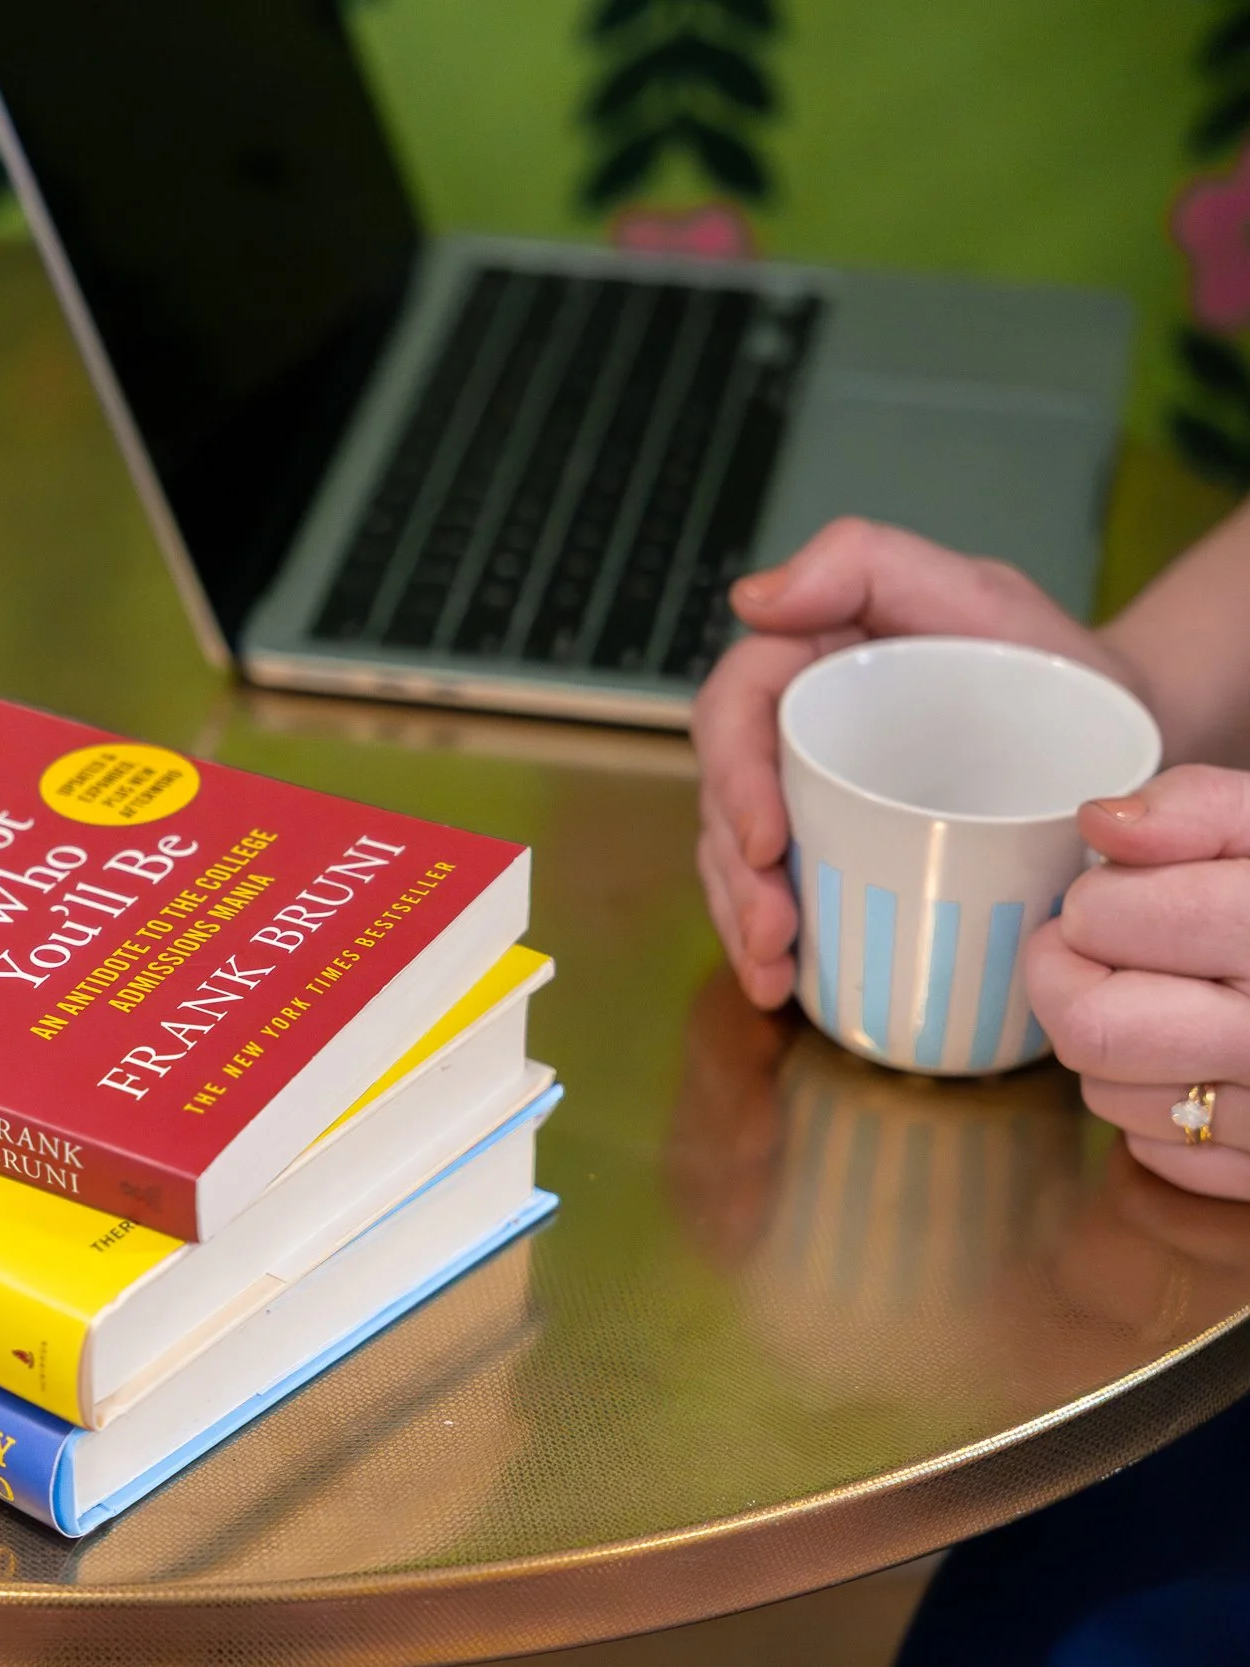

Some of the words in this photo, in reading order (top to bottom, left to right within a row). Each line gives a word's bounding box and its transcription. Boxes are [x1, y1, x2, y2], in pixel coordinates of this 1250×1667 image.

[30, 1014, 69, 1041] AN
[56, 939, 151, 1016] ANTIDOTE
[135, 919, 174, 940] TO
[159, 889, 209, 919] THE
[195, 828, 279, 890] COLLEGE
[102, 834, 199, 885] Be
[108, 920, 222, 1014] ADMISSIONS
[207, 874, 276, 920] MANIA
[96, 955, 277, 1101] FRANK
[250, 834, 406, 954] BRUNI
[183, 1082, 227, 1115] THE
[223, 1041, 266, 1079] NEW
[260, 996, 312, 1039] YORK
[305, 949, 361, 996] TIMES
[354, 861, 457, 948] BESTSELLER
[89, 1219, 138, 1253] THER
